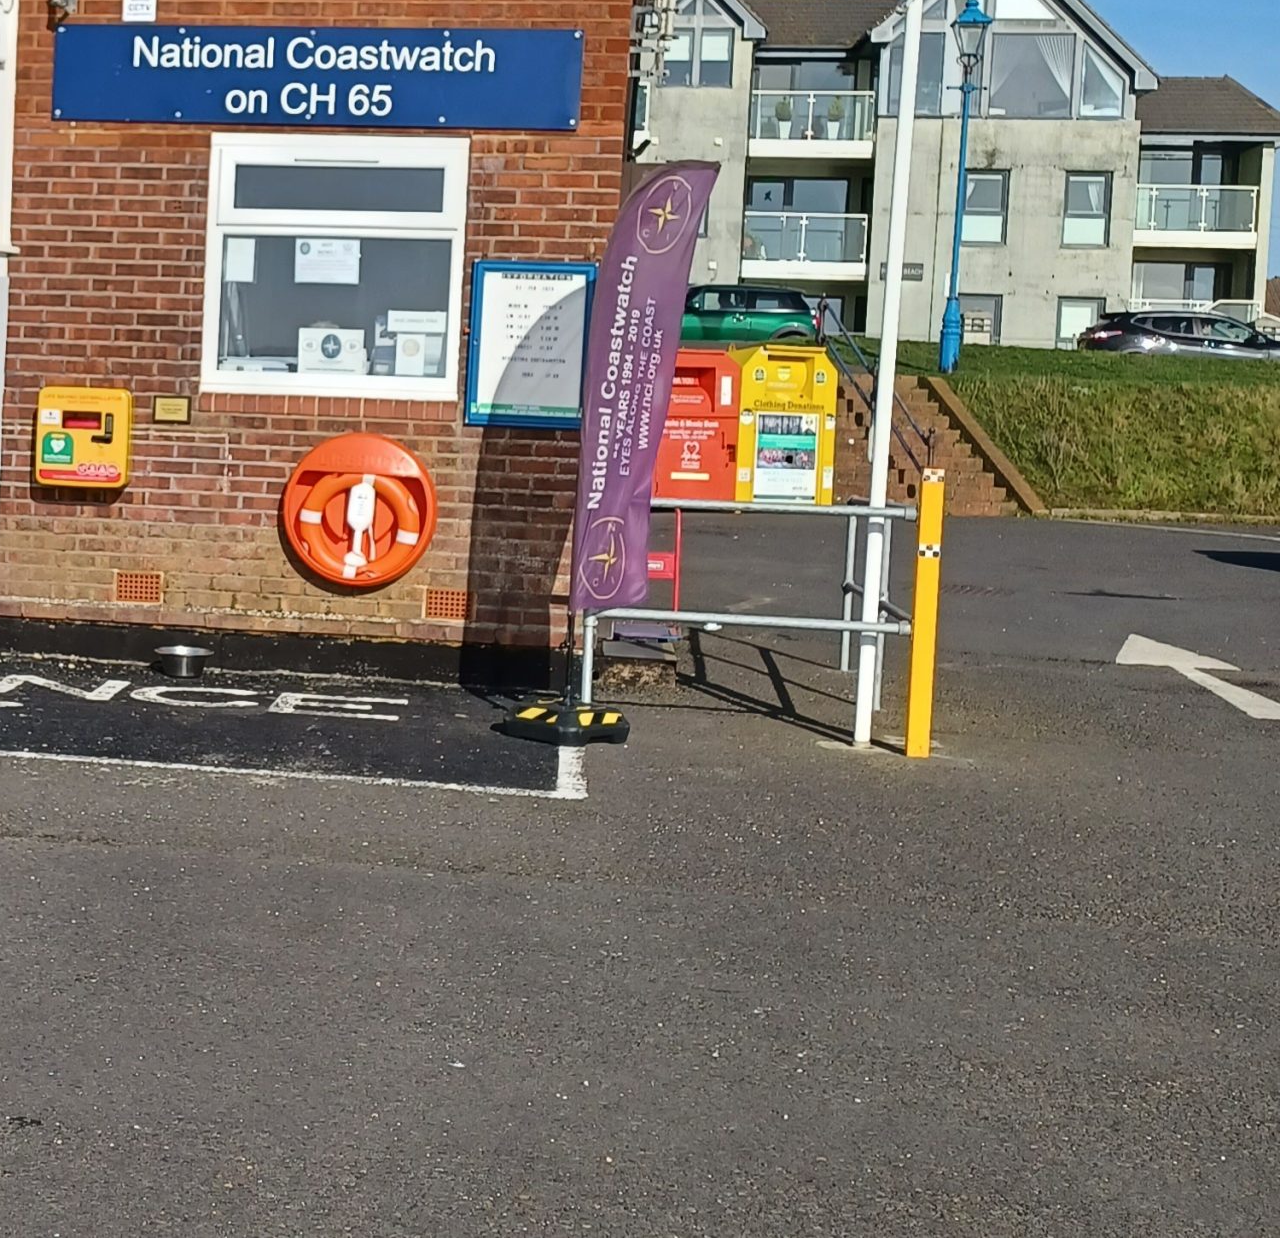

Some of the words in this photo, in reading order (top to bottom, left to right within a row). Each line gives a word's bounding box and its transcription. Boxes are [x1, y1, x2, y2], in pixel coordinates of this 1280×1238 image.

[132, 35, 275, 68] National
[286, 37, 495, 72] Coastwatch
[224, 89, 268, 114] on
[280, 82, 336, 115] CH
[348, 84, 392, 116] 65
[628, 309, 641, 342] 2019
[641, 296, 656, 347] COAST
[587, 407, 613, 510] National
[600, 255, 638, 400] Coastwatch
[622, 354, 634, 386] 1994
[637, 351, 649, 379] THE
[637, 329, 664, 450] www.nci.org.uk
[753, 399, 786, 411] Clothing
[787, 400, 824, 411] Donations
[615, 390, 631, 440] YEARS
[625, 383, 642, 435] ALONG
[619, 438, 632, 476] EYES
